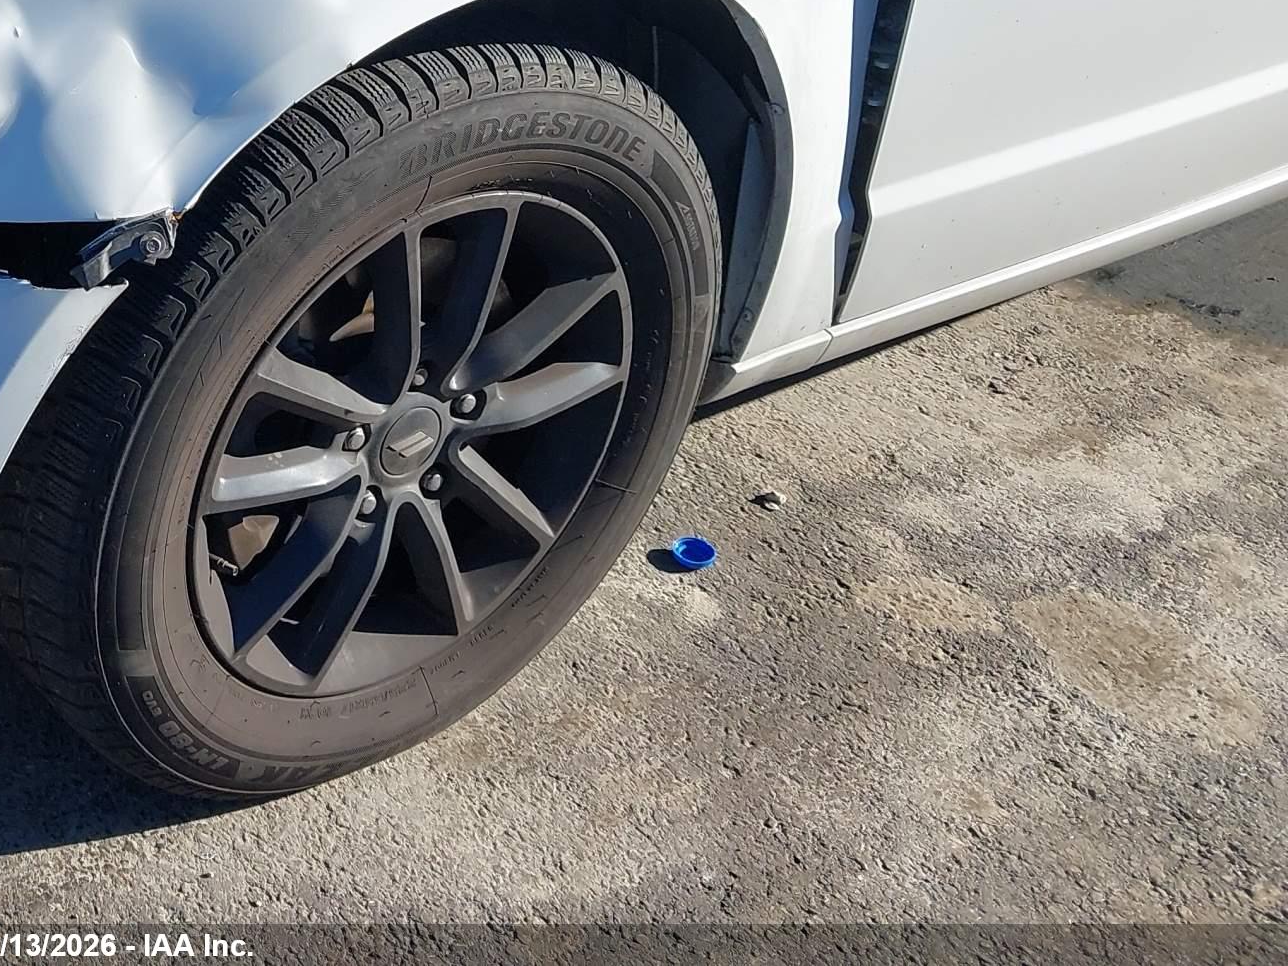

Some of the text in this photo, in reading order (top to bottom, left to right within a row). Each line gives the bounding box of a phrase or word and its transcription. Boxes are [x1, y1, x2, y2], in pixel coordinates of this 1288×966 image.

[399, 111, 647, 181] BRIDGESTONE
[142, 690, 230, 771] LM-80 EVO
